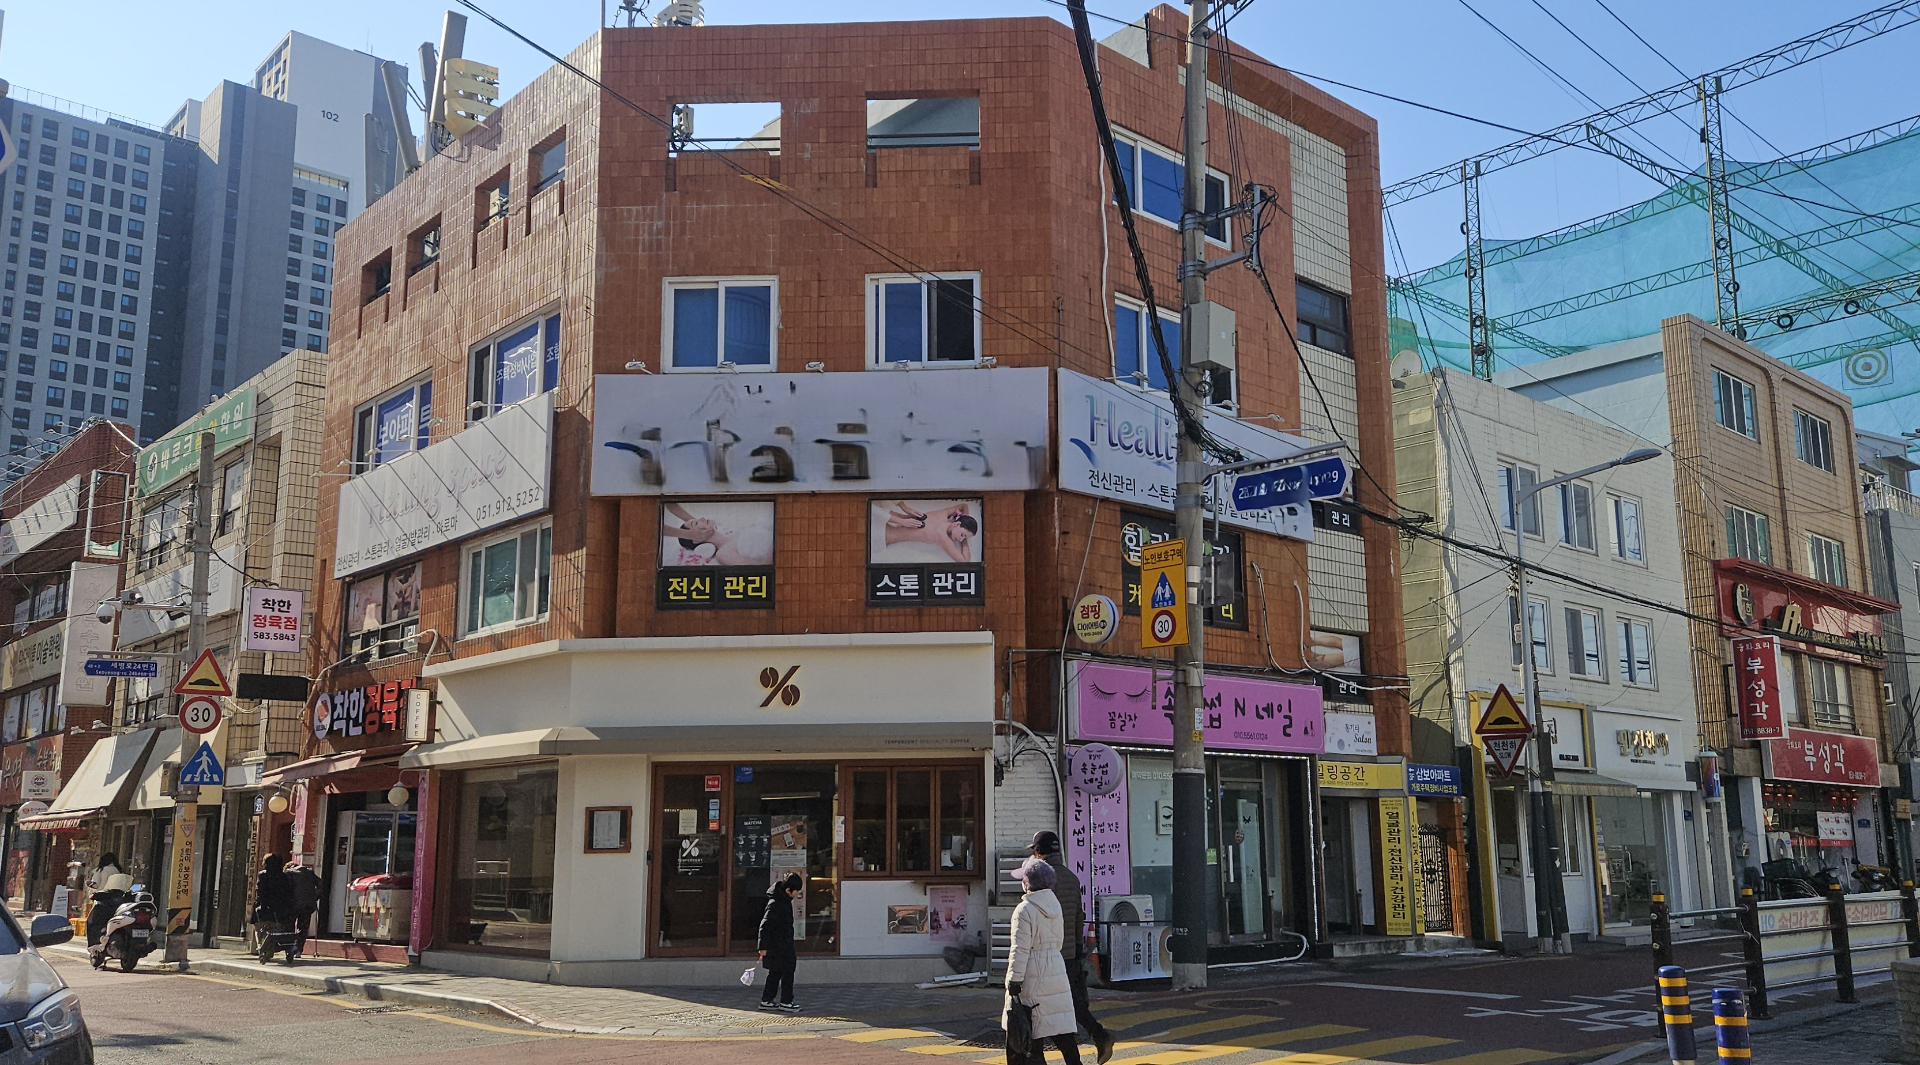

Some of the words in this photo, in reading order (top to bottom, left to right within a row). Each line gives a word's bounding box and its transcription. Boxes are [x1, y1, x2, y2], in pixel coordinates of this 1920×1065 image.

[321, 109, 340, 123] 102
[1088, 469, 1136, 496] 전신관리
[1144, 548, 1182, 566] 노인보호구역
[667, 576, 711, 600] 전신
[724, 576, 767, 599] 관리
[876, 573, 919, 597] 스톤
[932, 572, 976, 595] 관리
[262, 597, 292, 613] 착한
[1080, 602, 1102, 620] 점핑
[253, 614, 298, 631] 정육점
[1157, 619, 1170, 634] 30
[253, 631, 296, 642] 583.5843
[1746, 656, 1769, 721] 부성각
[190, 707, 211, 722] 30
[1107, 711, 1138, 732] 꼼실장
[1234, 697, 1246, 718] N
[1255, 698, 1293, 738] 네일
[1493, 739, 1517, 751] 천천히
[1804, 739, 1845, 774] 부성각
[1081, 762, 1109, 776] 속눈썹
